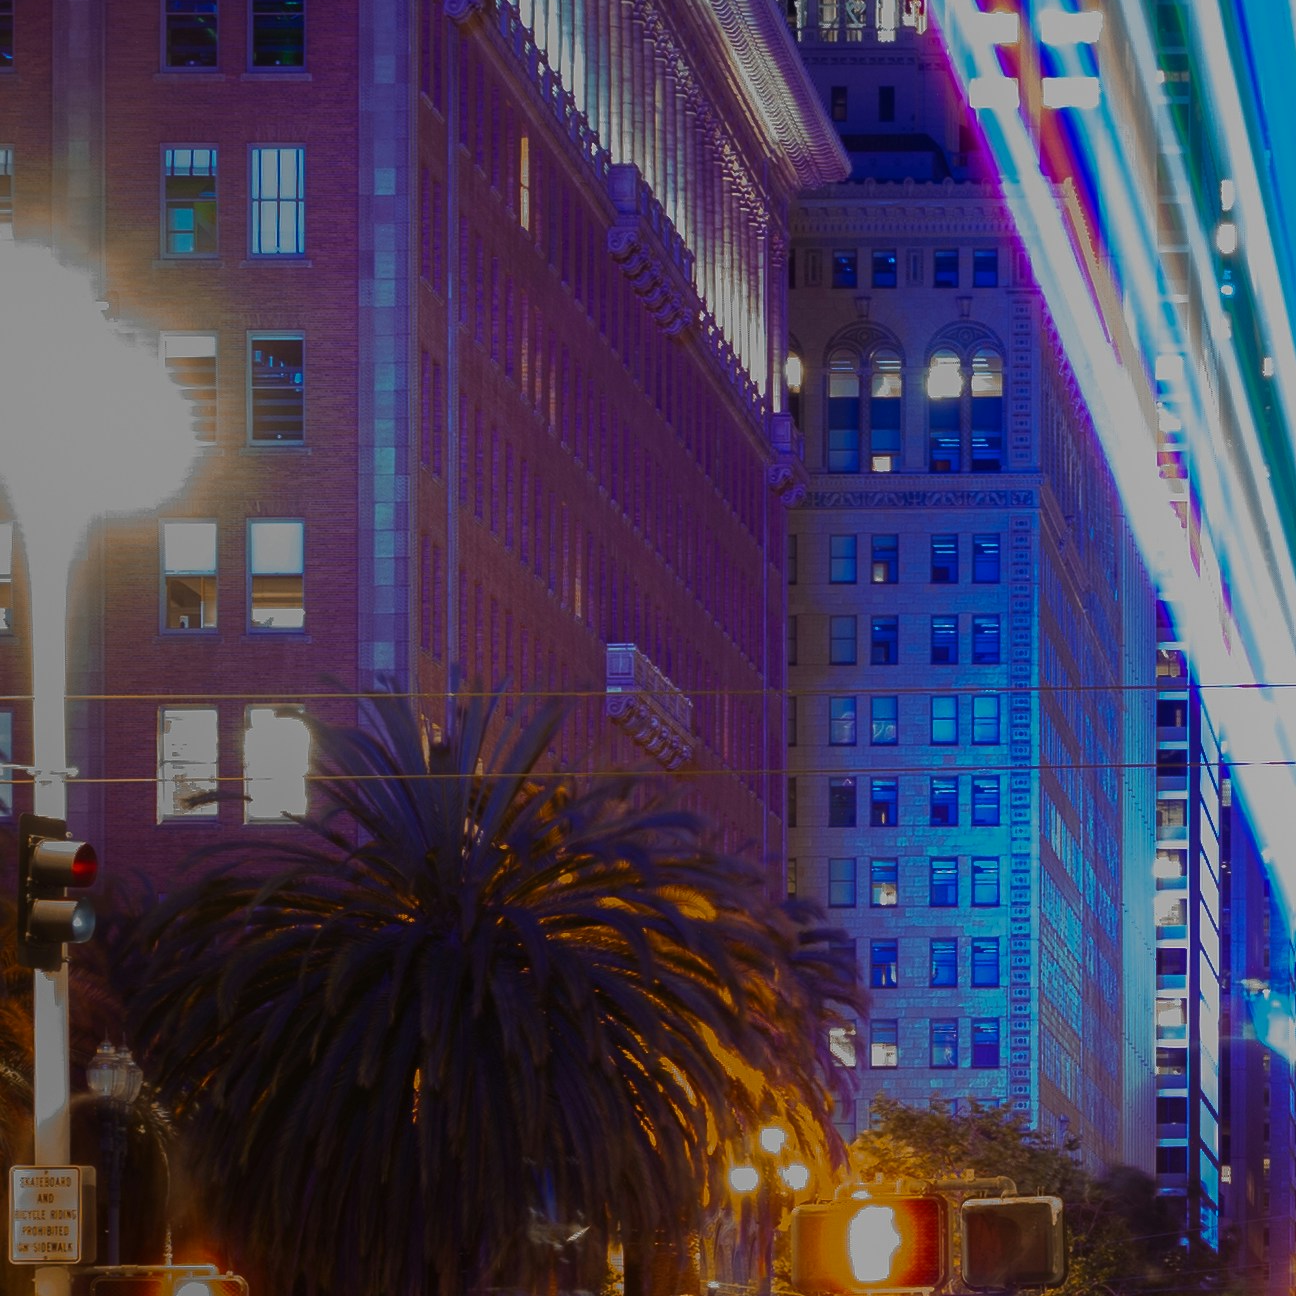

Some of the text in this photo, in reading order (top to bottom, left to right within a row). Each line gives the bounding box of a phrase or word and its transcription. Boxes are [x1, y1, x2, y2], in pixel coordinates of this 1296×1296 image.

[19, 1176, 72, 1188] SKATEBOARD
[37, 1192, 55, 1204] AND
[50, 1209, 77, 1221] RIDING
[21, 1225, 70, 1237] PROHIBITED
[33, 1242, 73, 1253] SIDEWALK
